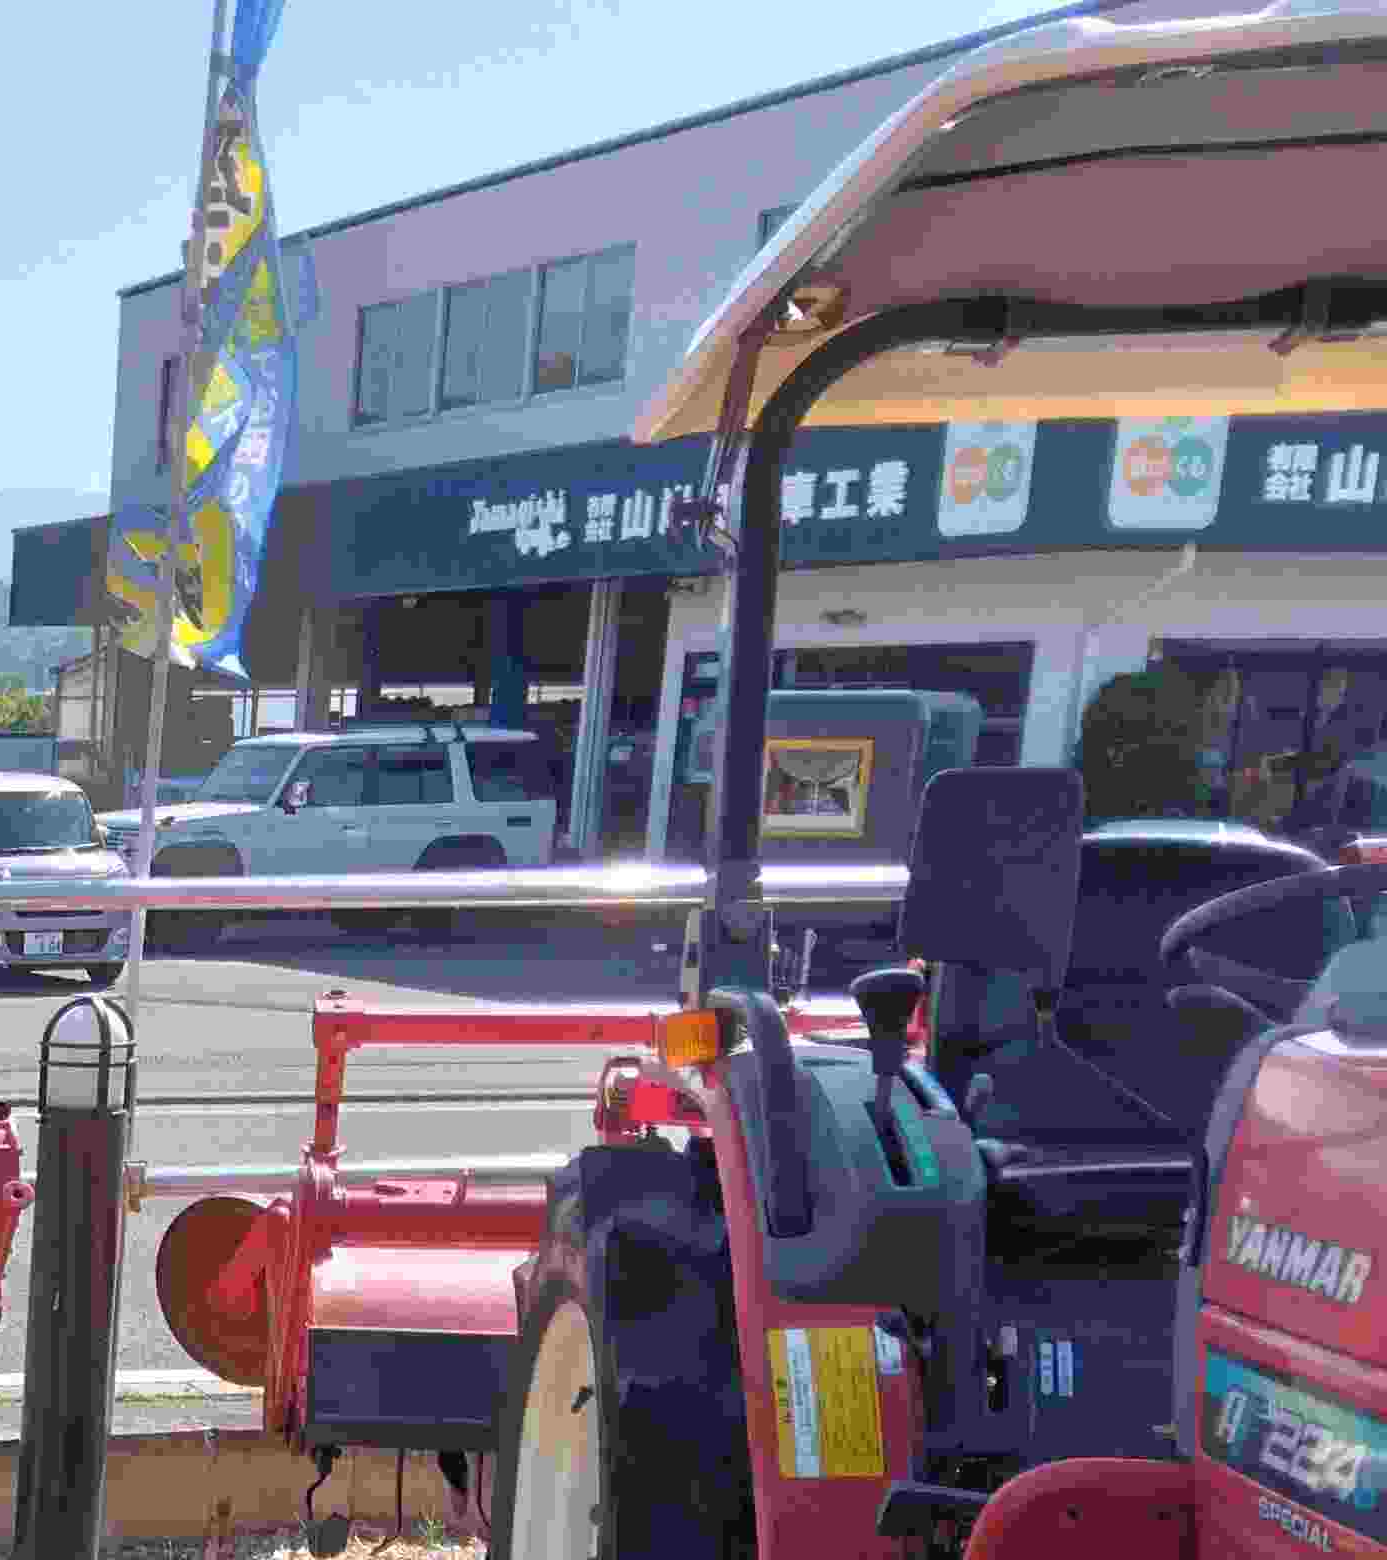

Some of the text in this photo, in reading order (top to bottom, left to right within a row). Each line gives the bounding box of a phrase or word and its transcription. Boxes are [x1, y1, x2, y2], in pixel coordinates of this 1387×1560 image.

[1322, 443, 1387, 503] 山
[1227, 1214, 1373, 1304] YANMAR
[1258, 1497, 1334, 1553] SPECIAL
